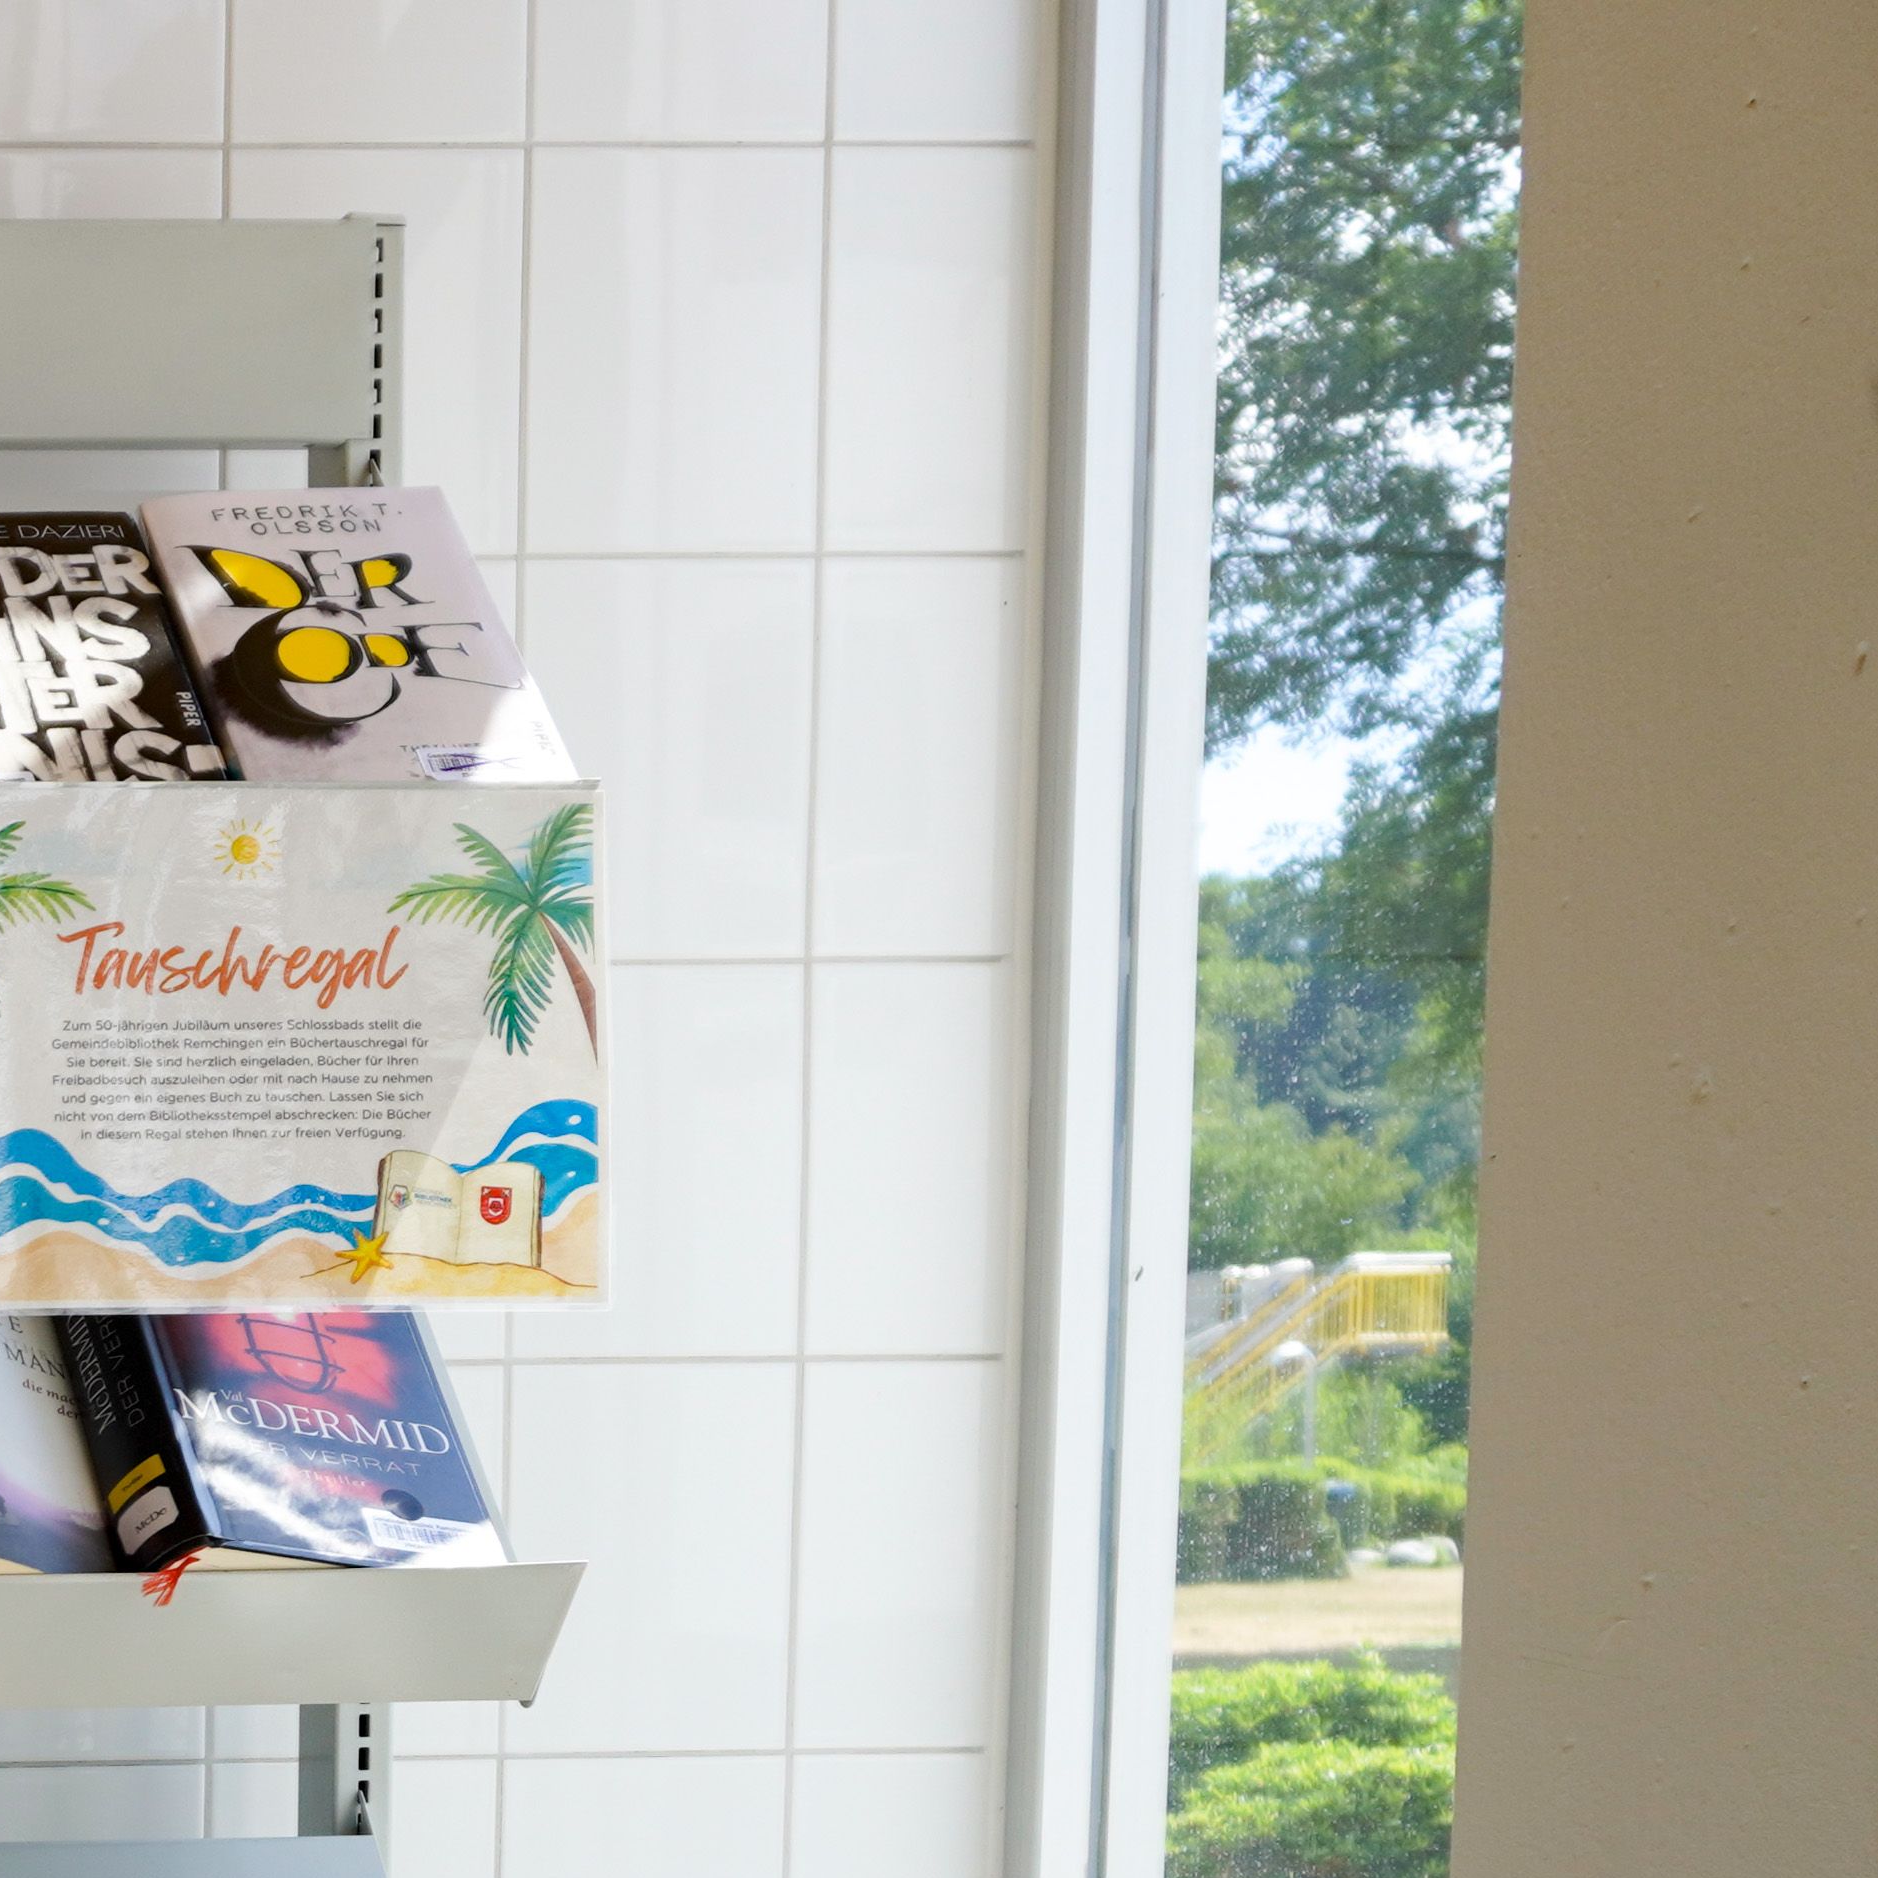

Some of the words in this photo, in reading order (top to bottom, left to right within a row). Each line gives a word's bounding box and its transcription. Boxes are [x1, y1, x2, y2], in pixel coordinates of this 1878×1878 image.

[211, 505, 358, 522] FREDRIK
[372, 502, 402, 516] T.
[17, 524, 125, 540] DAZIERI
[250, 519, 381, 536] OLSSON
[176, 691, 203, 727] PIPER
[55, 920, 409, 1009] Tauschregal
[63, 1020, 92, 1032] Zum
[96, 1020, 168, 1034] 50-jährigen
[172, 1019, 230, 1031] Jubiläum
[234, 1021, 283, 1031] unseres
[287, 1019, 364, 1031] Schlossbads
[368, 1019, 399, 1031] stellt
[403, 1019, 422, 1031] die
[52, 1038, 179, 1050] Gemeindebibliothek
[183, 1038, 263, 1051] Remchingen
[267, 1038, 286, 1048] ein
[290, 1037, 407, 1050] Büchertauschregal
[411, 1037, 429, 1048] für
[175, 1388, 450, 1456] McDERMID
[298, 1445, 423, 1477] VERRAT
